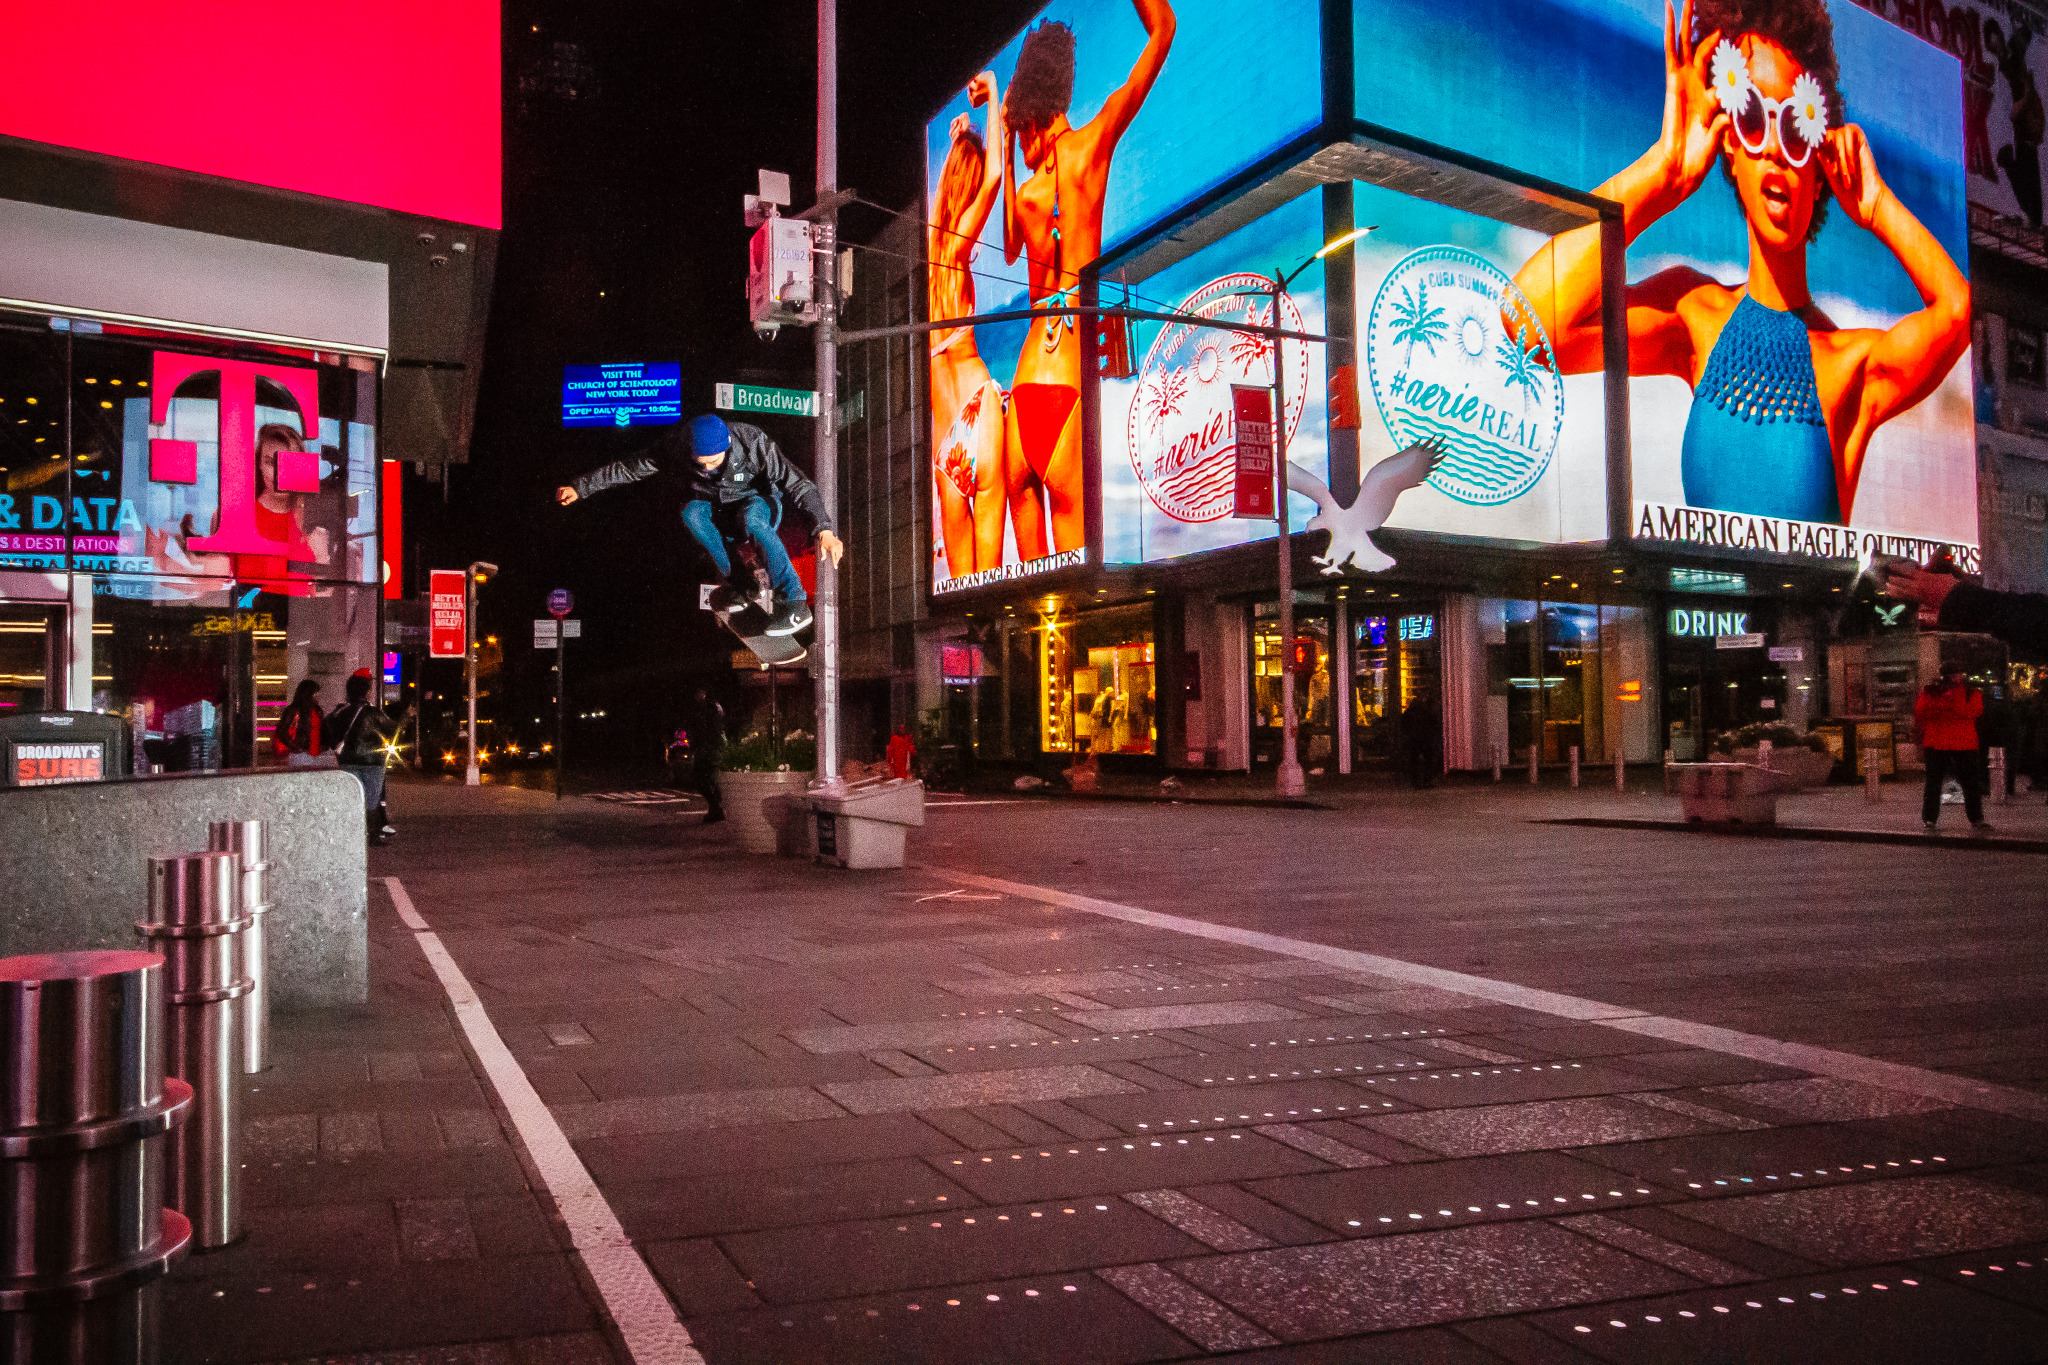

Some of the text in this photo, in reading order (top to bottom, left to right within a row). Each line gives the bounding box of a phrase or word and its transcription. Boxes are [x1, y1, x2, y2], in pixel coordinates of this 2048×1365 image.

[1428, 271, 1456, 288] CUBA
[1458, 273, 1499, 301] SUMMER
[1163, 328, 1187, 362] CUBA
[1225, 295, 1246, 313] 2017
[568, 379, 678, 390] CHURCH OF SCIENTOLOGY
[601, 370, 642, 379] VISIT THE
[586, 389, 660, 399] NEW YORK TODAY
[738, 388, 811, 416] Broadway
[569, 407, 593, 416] OPEN
[593, 407, 616, 415] DAILY
[1389, 370, 1542, 452] #aerie REAL
[1154, 407, 1224, 479] #aerie
[32, 496, 142, 532] DATA
[1639, 503, 1981, 575] AMERICAN EAGLE OUTFITERS
[935, 549, 1081, 596] AMERICAN EAGLE OUTFITTERS
[92, 584, 144, 596] MOBILE
[1673, 608, 1748, 637] DRINK
[17, 745, 101, 760] BROADWAY'S
[18, 758, 101, 780] SURE
